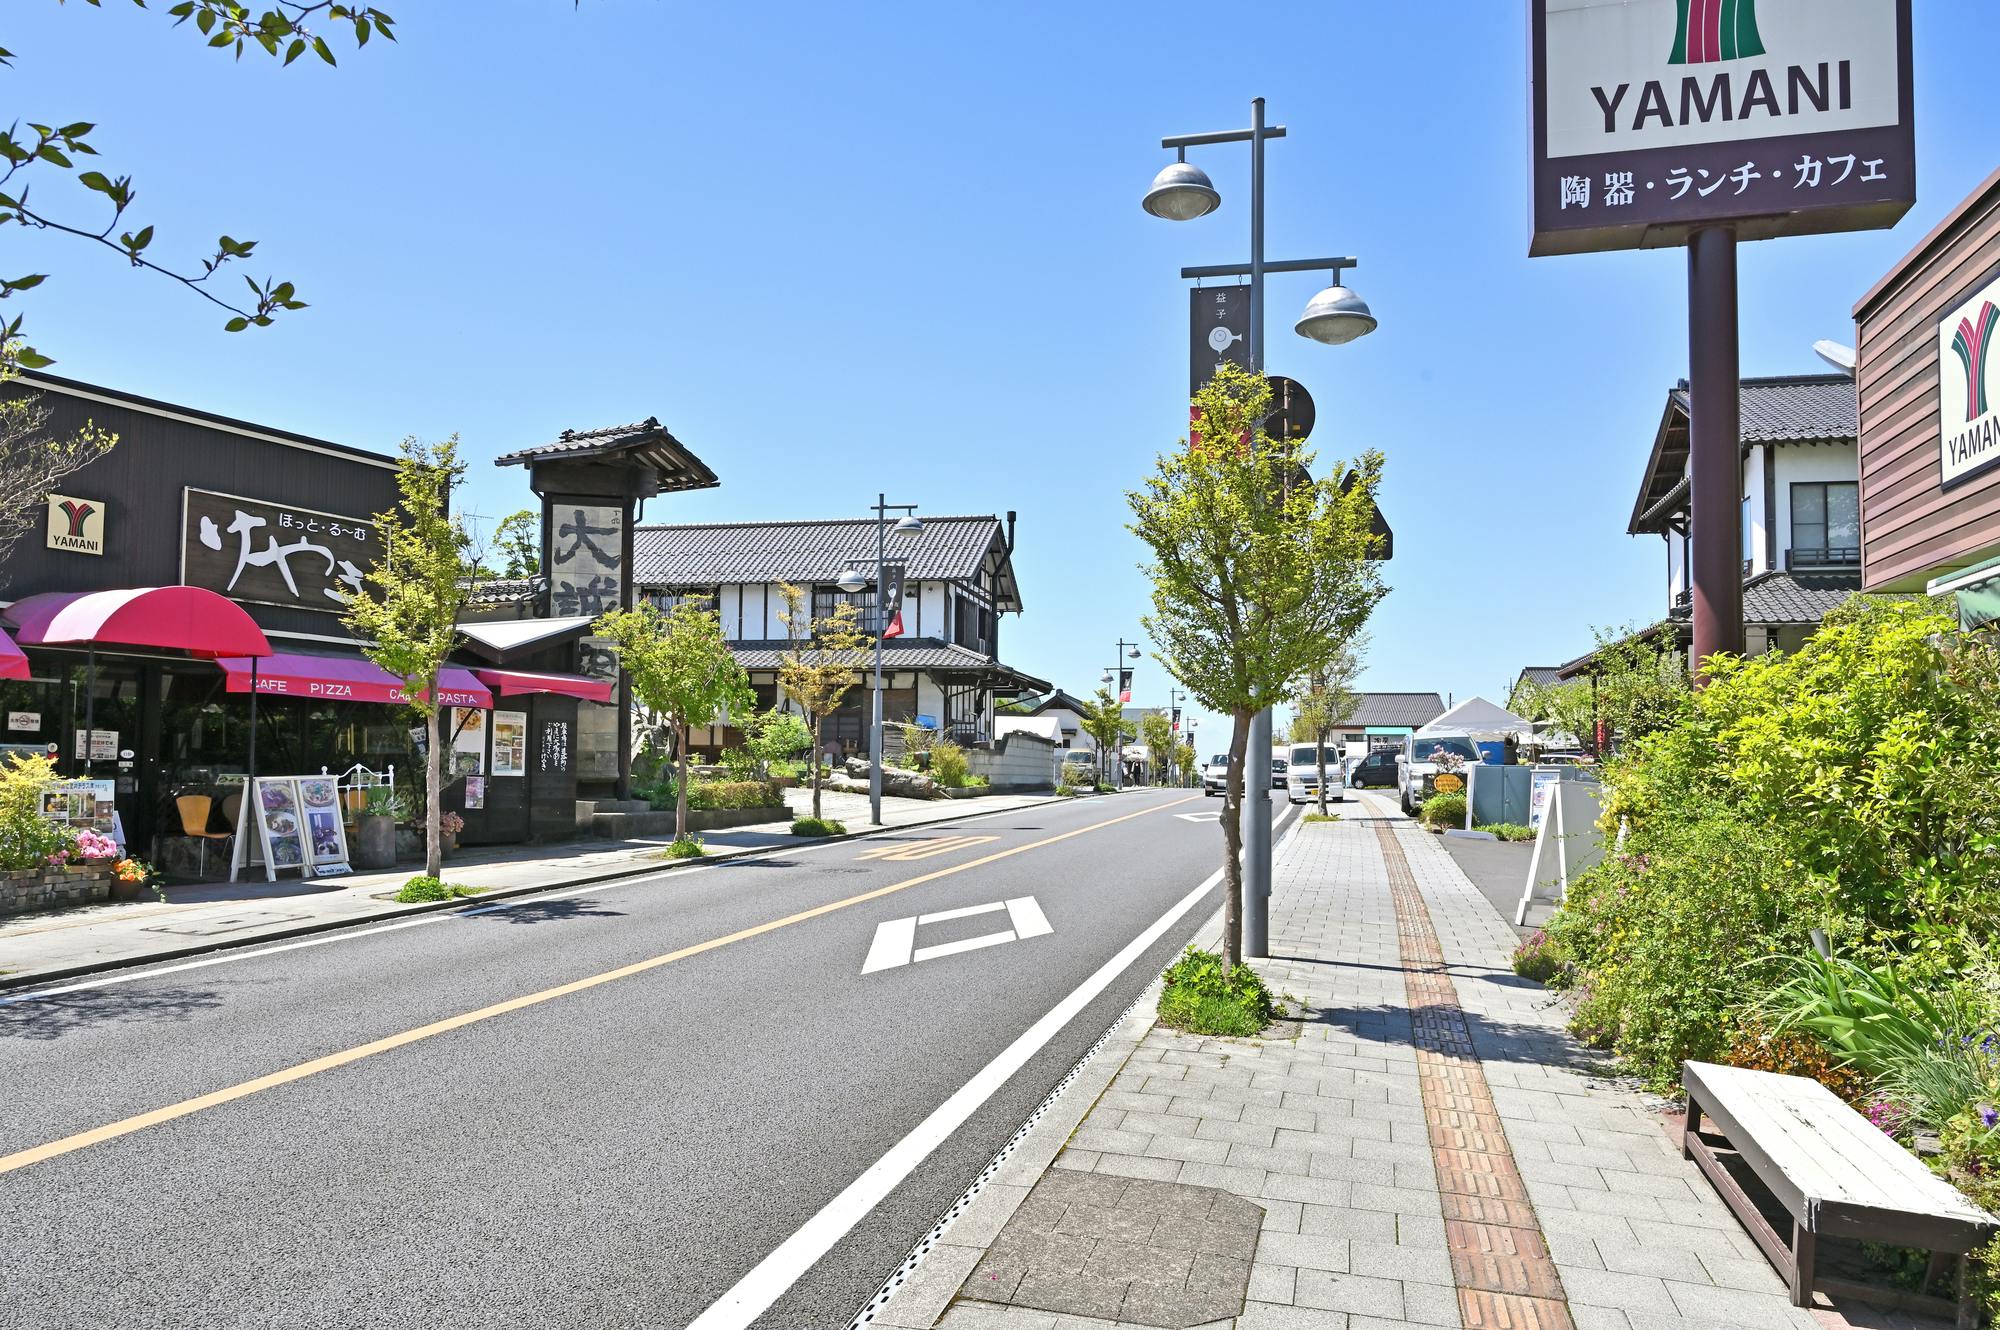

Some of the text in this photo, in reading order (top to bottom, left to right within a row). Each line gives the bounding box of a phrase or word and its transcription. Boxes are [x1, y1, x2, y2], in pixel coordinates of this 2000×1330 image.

[1590, 60, 1851, 133] YAMANI
[53, 535, 98, 551] YAMANI
[310, 683, 352, 696] PIZZA
[438, 693, 477, 704] PASTA
